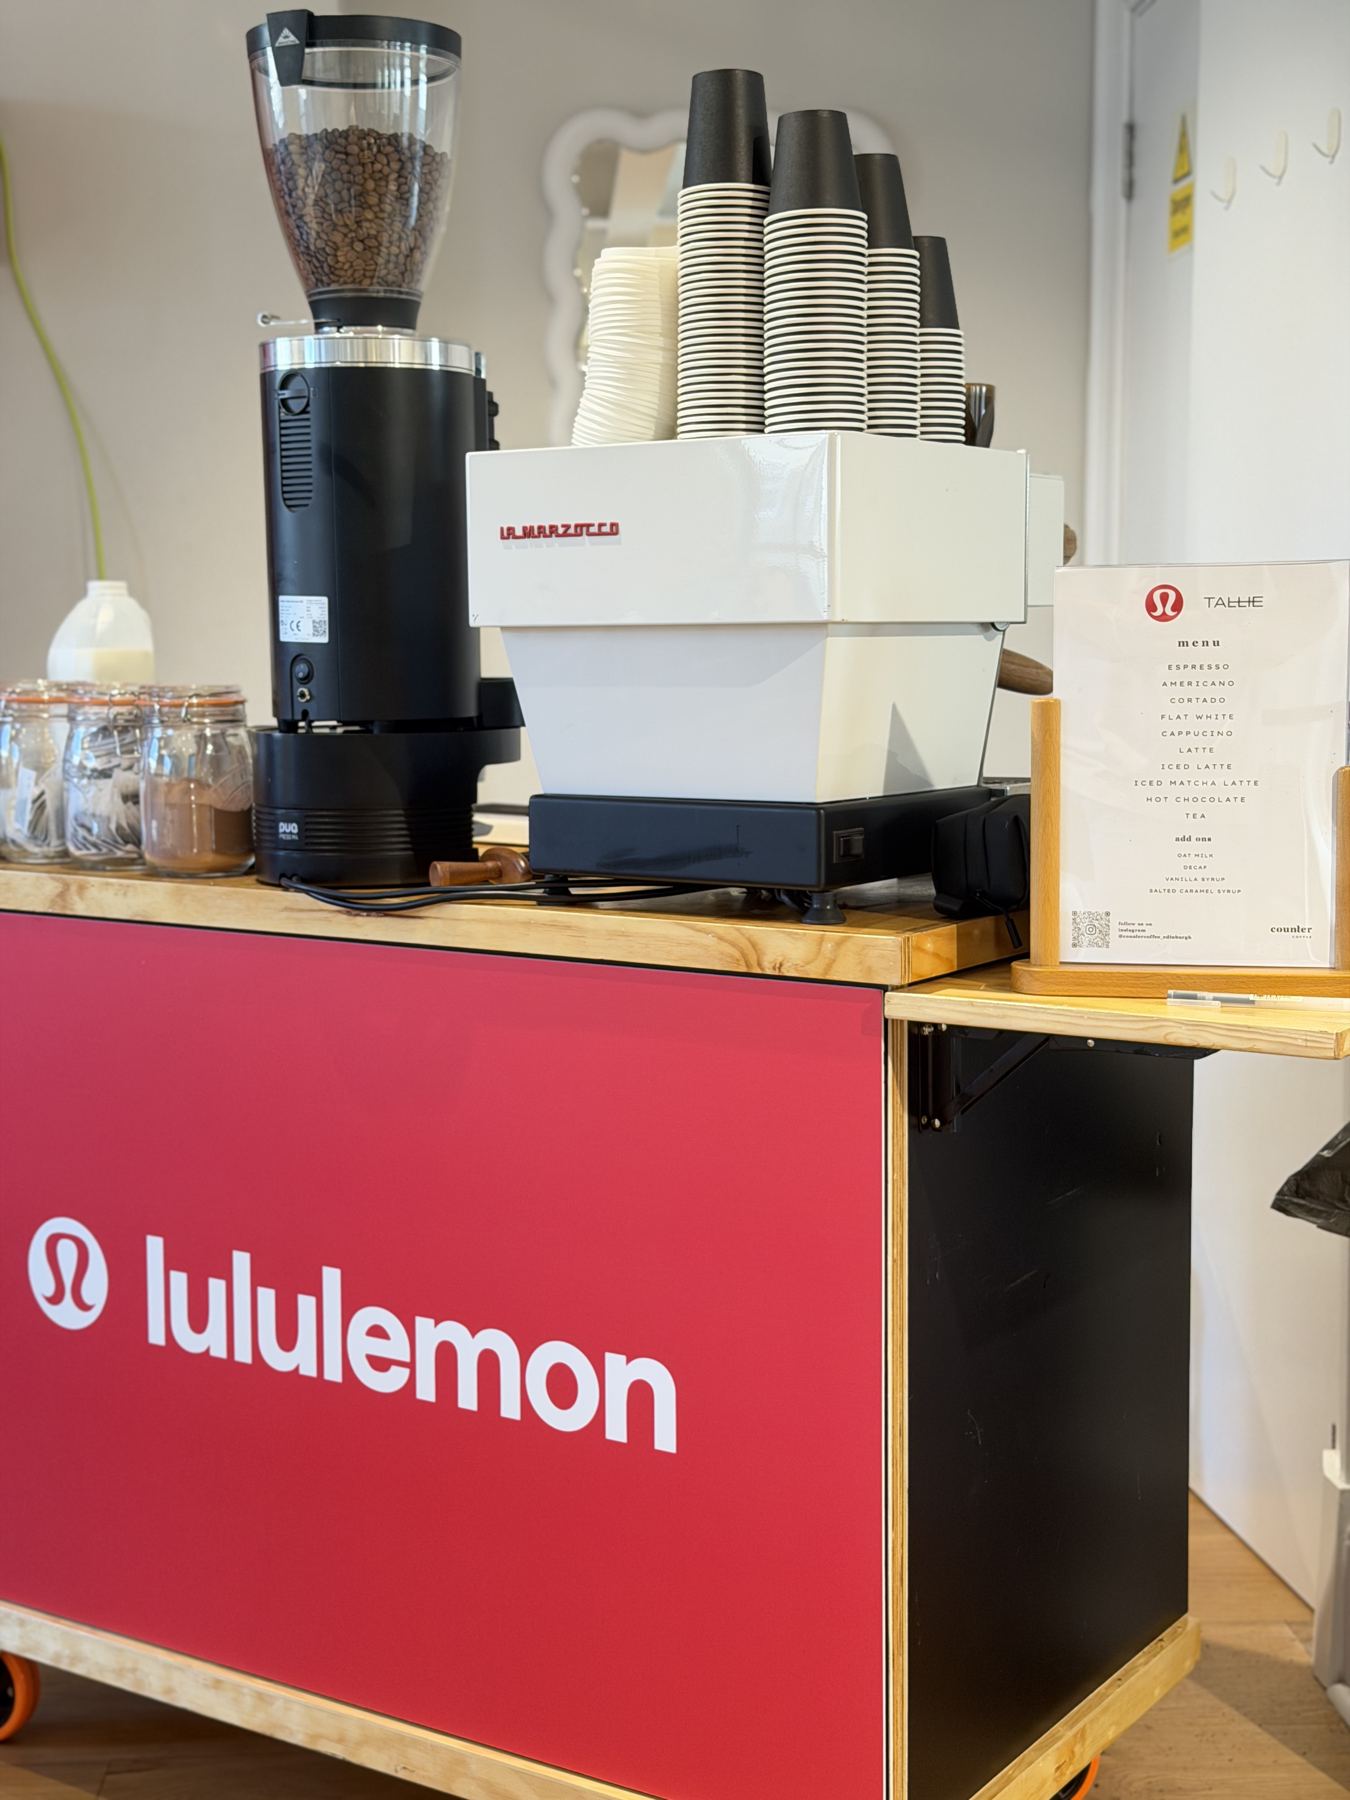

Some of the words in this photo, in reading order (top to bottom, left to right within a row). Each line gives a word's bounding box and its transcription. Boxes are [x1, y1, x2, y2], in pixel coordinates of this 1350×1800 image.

[500, 526, 516, 540] LA
[522, 522, 619, 540] MARZOCCO
[1177, 639, 1221, 648] menu
[1167, 663, 1230, 672] ESPRESSO
[1161, 680, 1235, 689] AMERICANO
[1169, 696, 1226, 705] CORTADO
[1160, 713, 1190, 722] FLAT
[1194, 713, 1234, 721] WHITE
[1160, 729, 1233, 738] CAPPUCINO
[1178, 746, 1215, 754] LATTE
[1160, 763, 1190, 771] ICED
[1196, 763, 1232, 771] LATTE
[1134, 779, 1163, 787] ICED
[1169, 779, 1217, 787] MATCHA
[1223, 779, 1259, 787] LATTE
[1174, 795, 1247, 804] CHOCOLATE
[1184, 812, 1208, 821] TEA
[1174, 834, 1192, 843] add
[1270, 924, 1313, 934] counter
[146, 1234, 677, 1453] lululemon
